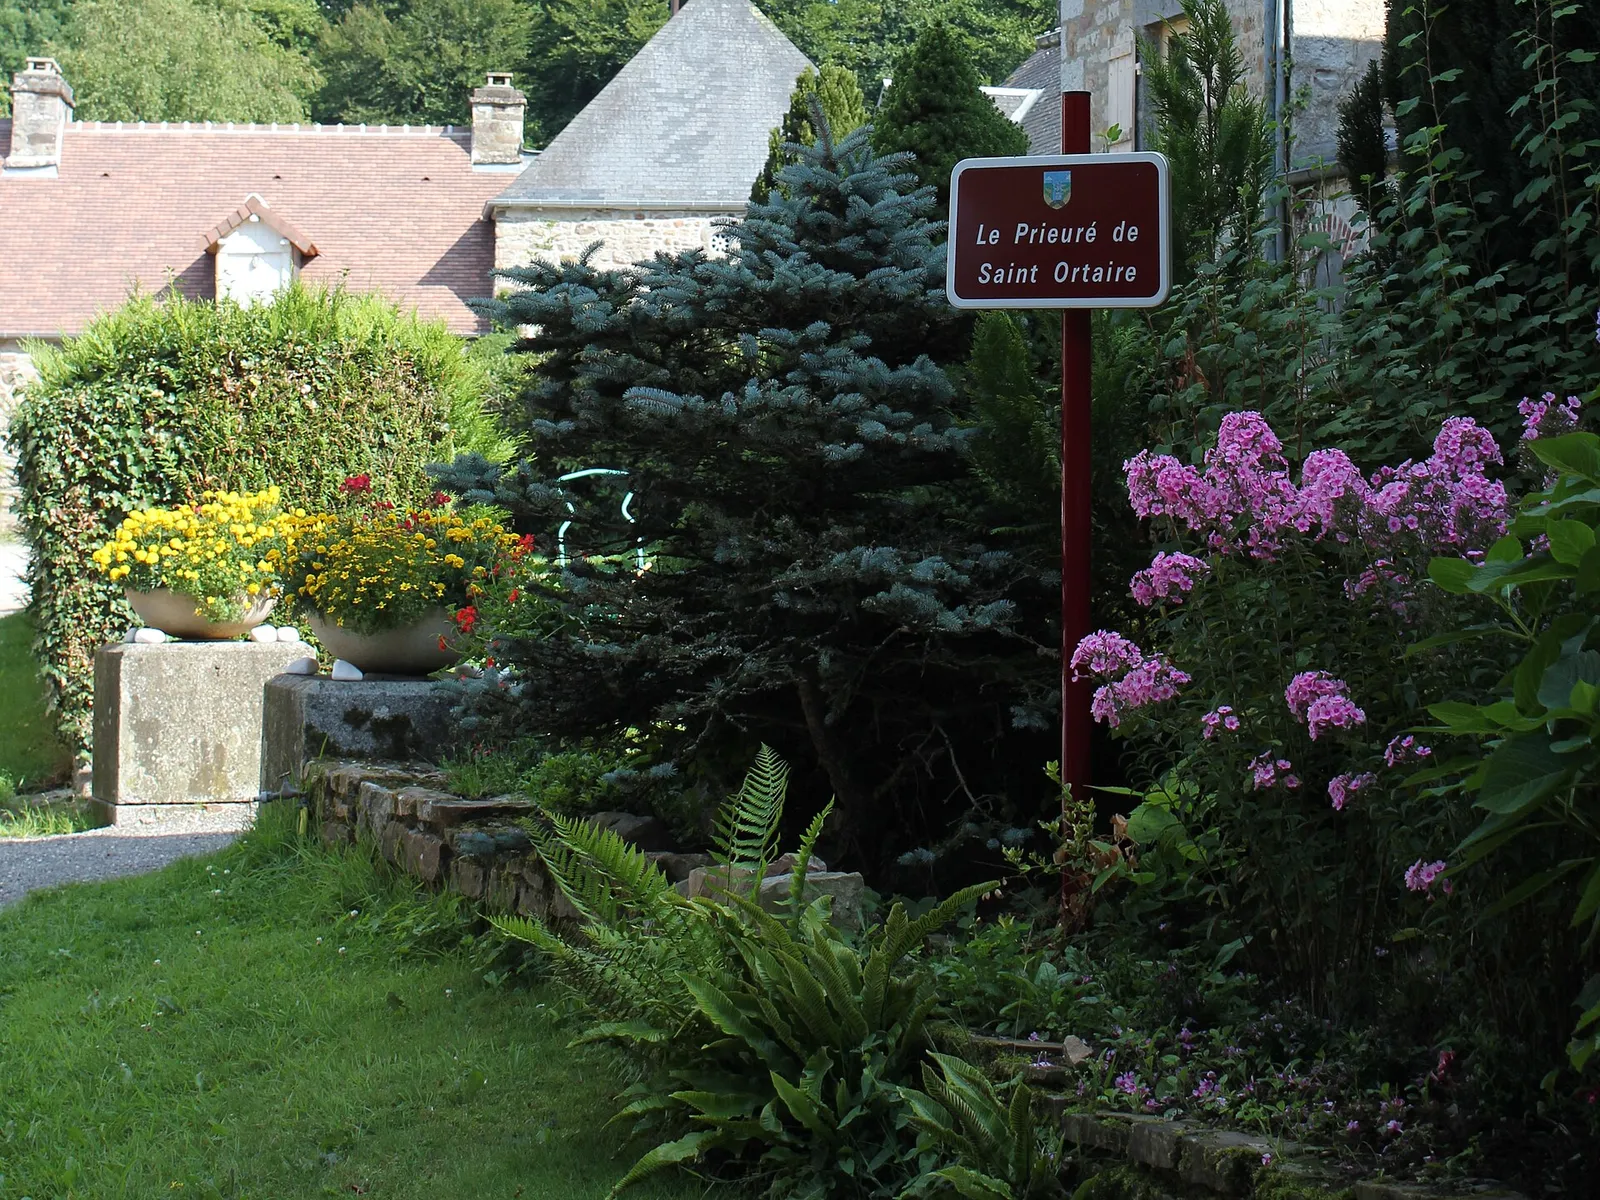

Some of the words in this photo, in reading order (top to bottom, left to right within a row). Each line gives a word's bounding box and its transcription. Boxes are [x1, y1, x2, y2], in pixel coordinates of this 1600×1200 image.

[976, 223, 1000, 245] Le
[1014, 221, 1097, 244] Prieuré
[1112, 220, 1139, 243] de
[977, 262, 1038, 284] Saint
[1053, 261, 1137, 283] Ortaire
